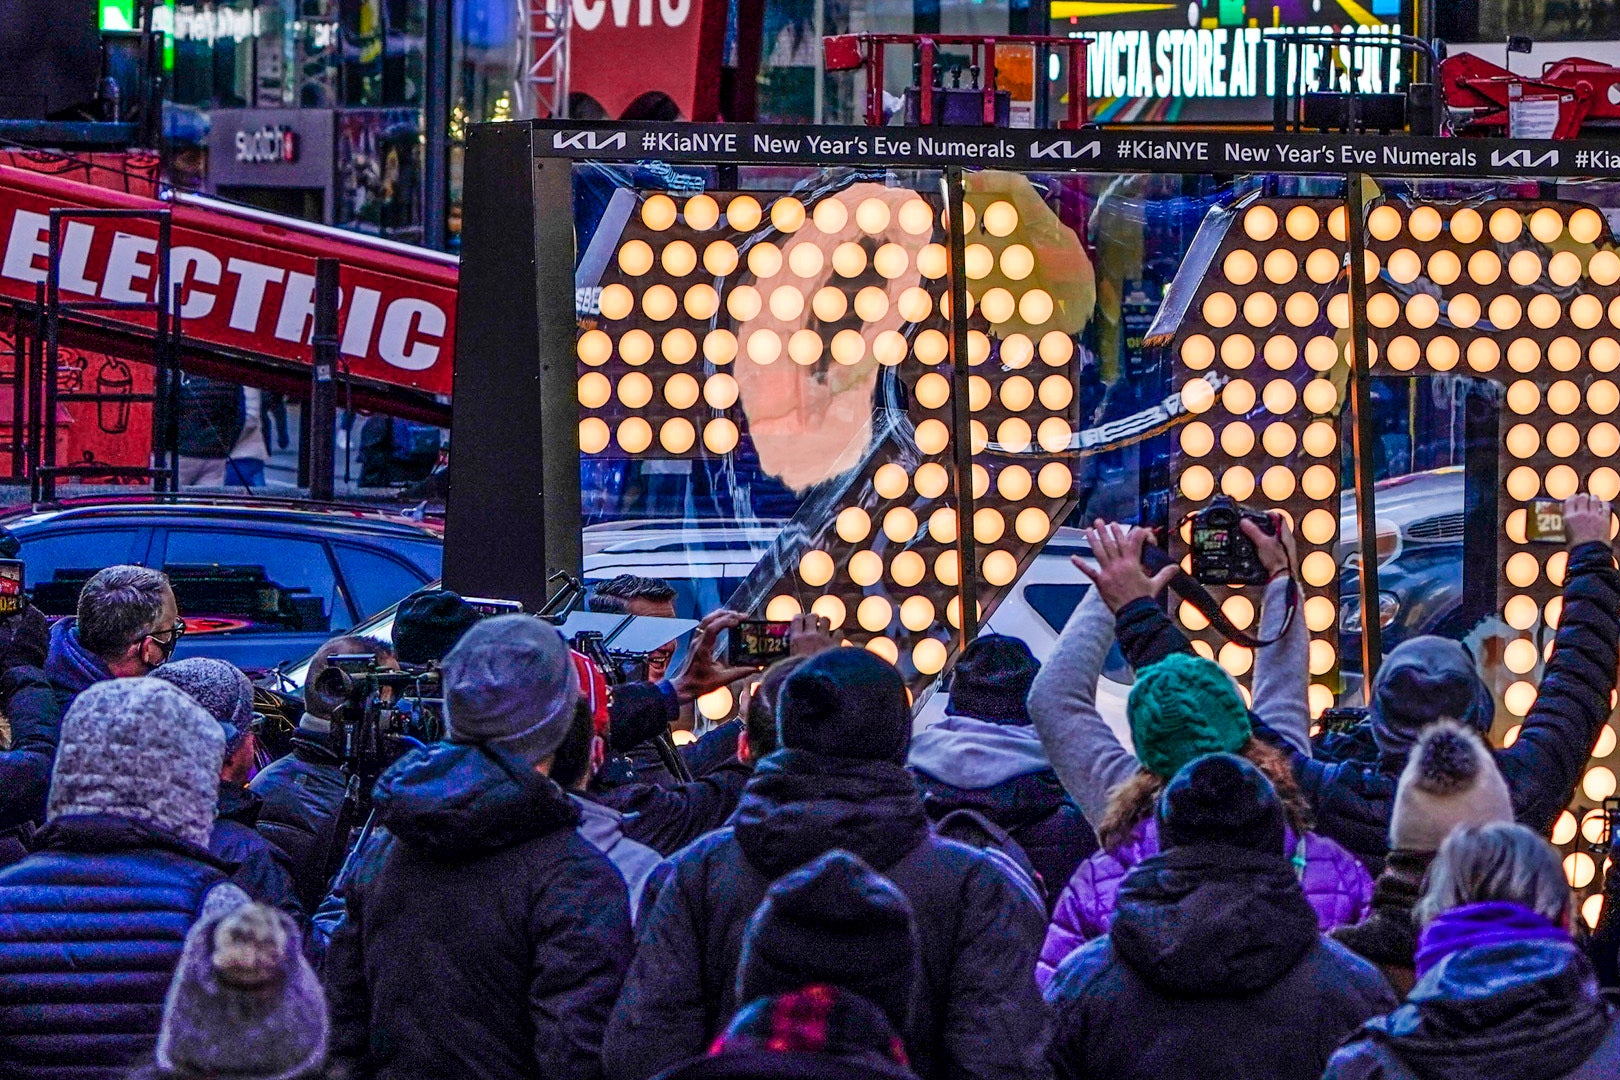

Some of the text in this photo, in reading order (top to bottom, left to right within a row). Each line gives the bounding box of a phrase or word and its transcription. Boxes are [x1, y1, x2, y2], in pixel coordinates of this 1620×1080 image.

[1156, 28, 1228, 98] STORE
[1229, 27, 1261, 97] AT
[642, 133, 737, 152] #KiaNYE
[754, 134, 801, 154] New
[806, 135, 868, 156] Year's
[874, 136, 911, 156] Eve
[917, 137, 1016, 158] Numerals
[1117, 141, 1209, 161] #KiaNYE
[1224, 143, 1271, 162] New
[1275, 144, 1336, 164] Year's
[1341, 145, 1377, 164] Eve
[1383, 145, 1477, 167] Numerals
[1, 208, 447, 372] ELECTRIC
